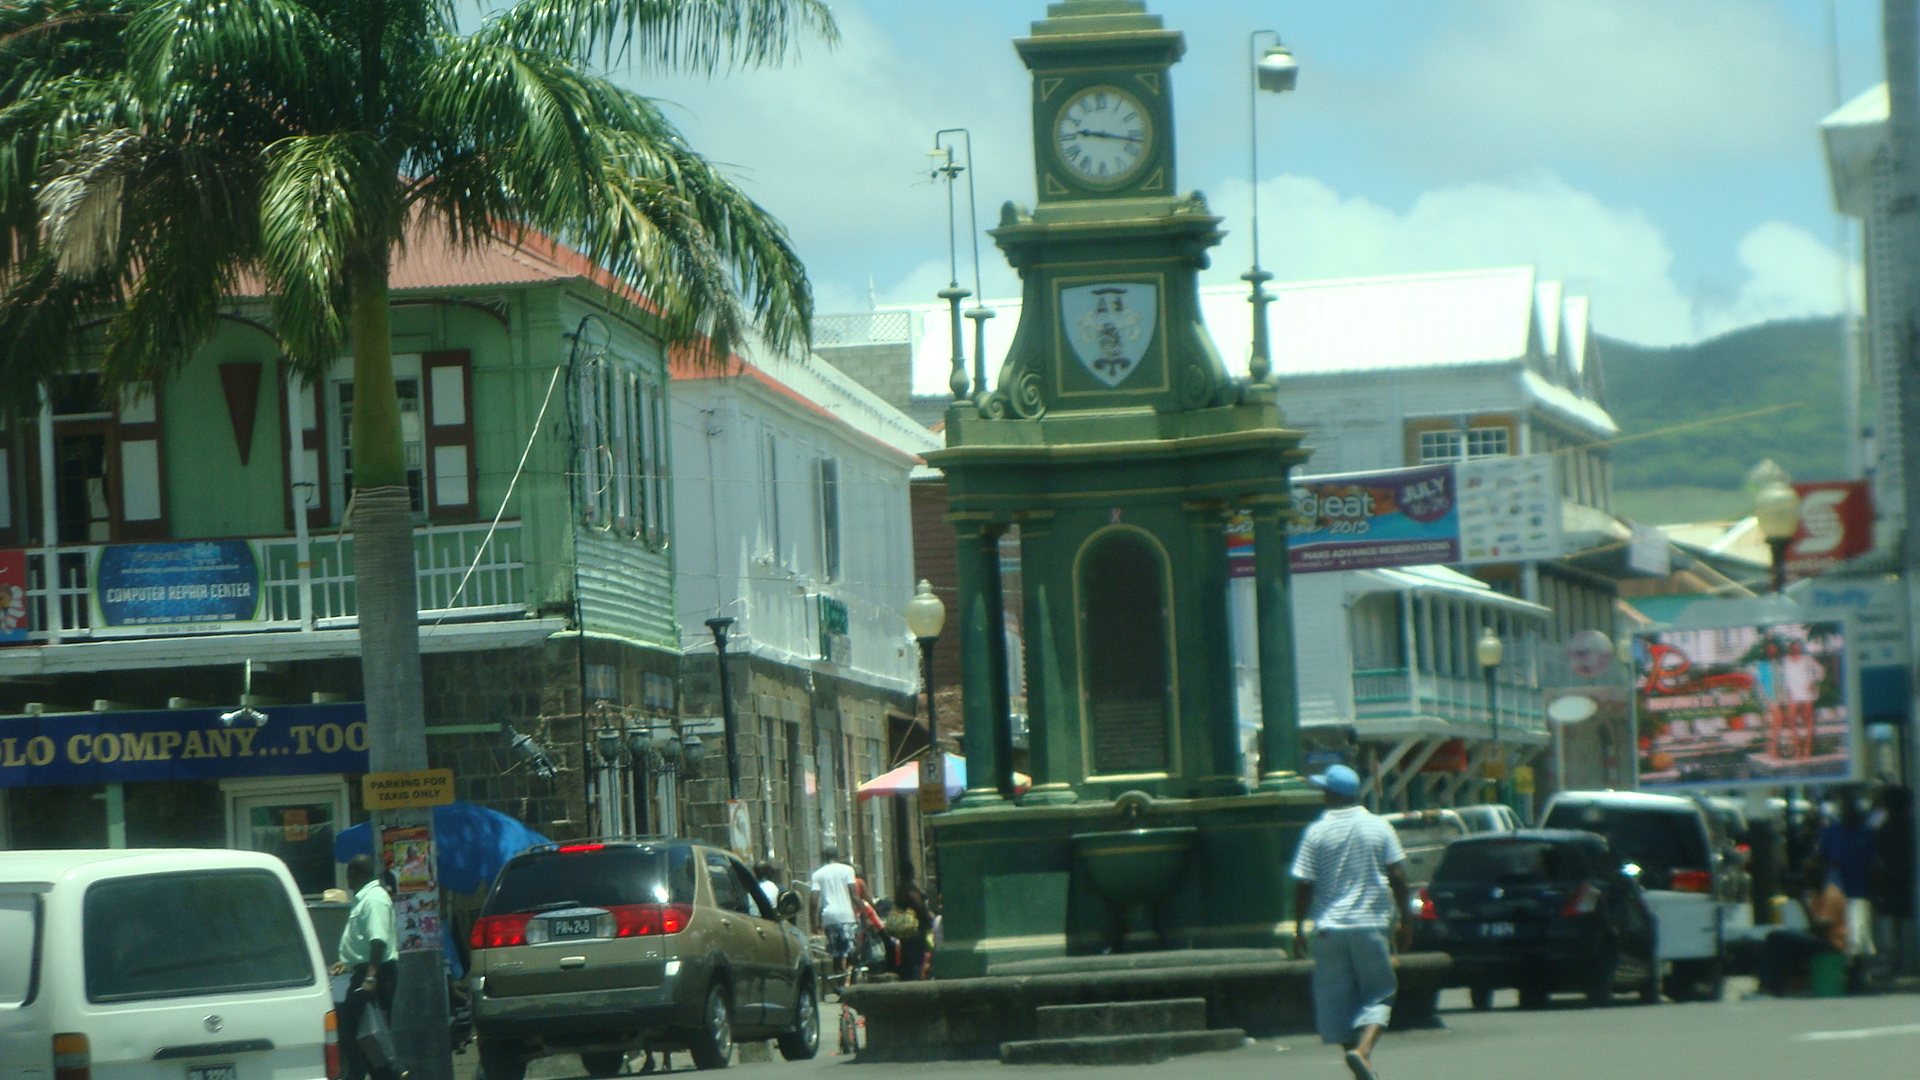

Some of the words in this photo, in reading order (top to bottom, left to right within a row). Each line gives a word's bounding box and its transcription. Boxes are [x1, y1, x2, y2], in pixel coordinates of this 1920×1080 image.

[106, 586, 165, 603] COMPUTER
[168, 584, 208, 600] REPAIR
[210, 582, 251, 598] CENTER
[370, 778, 421, 789] PARKING
[423, 776, 447, 786] FOR
[378, 791, 410, 801] TAXIS
[412, 789, 440, 799] ONLY
